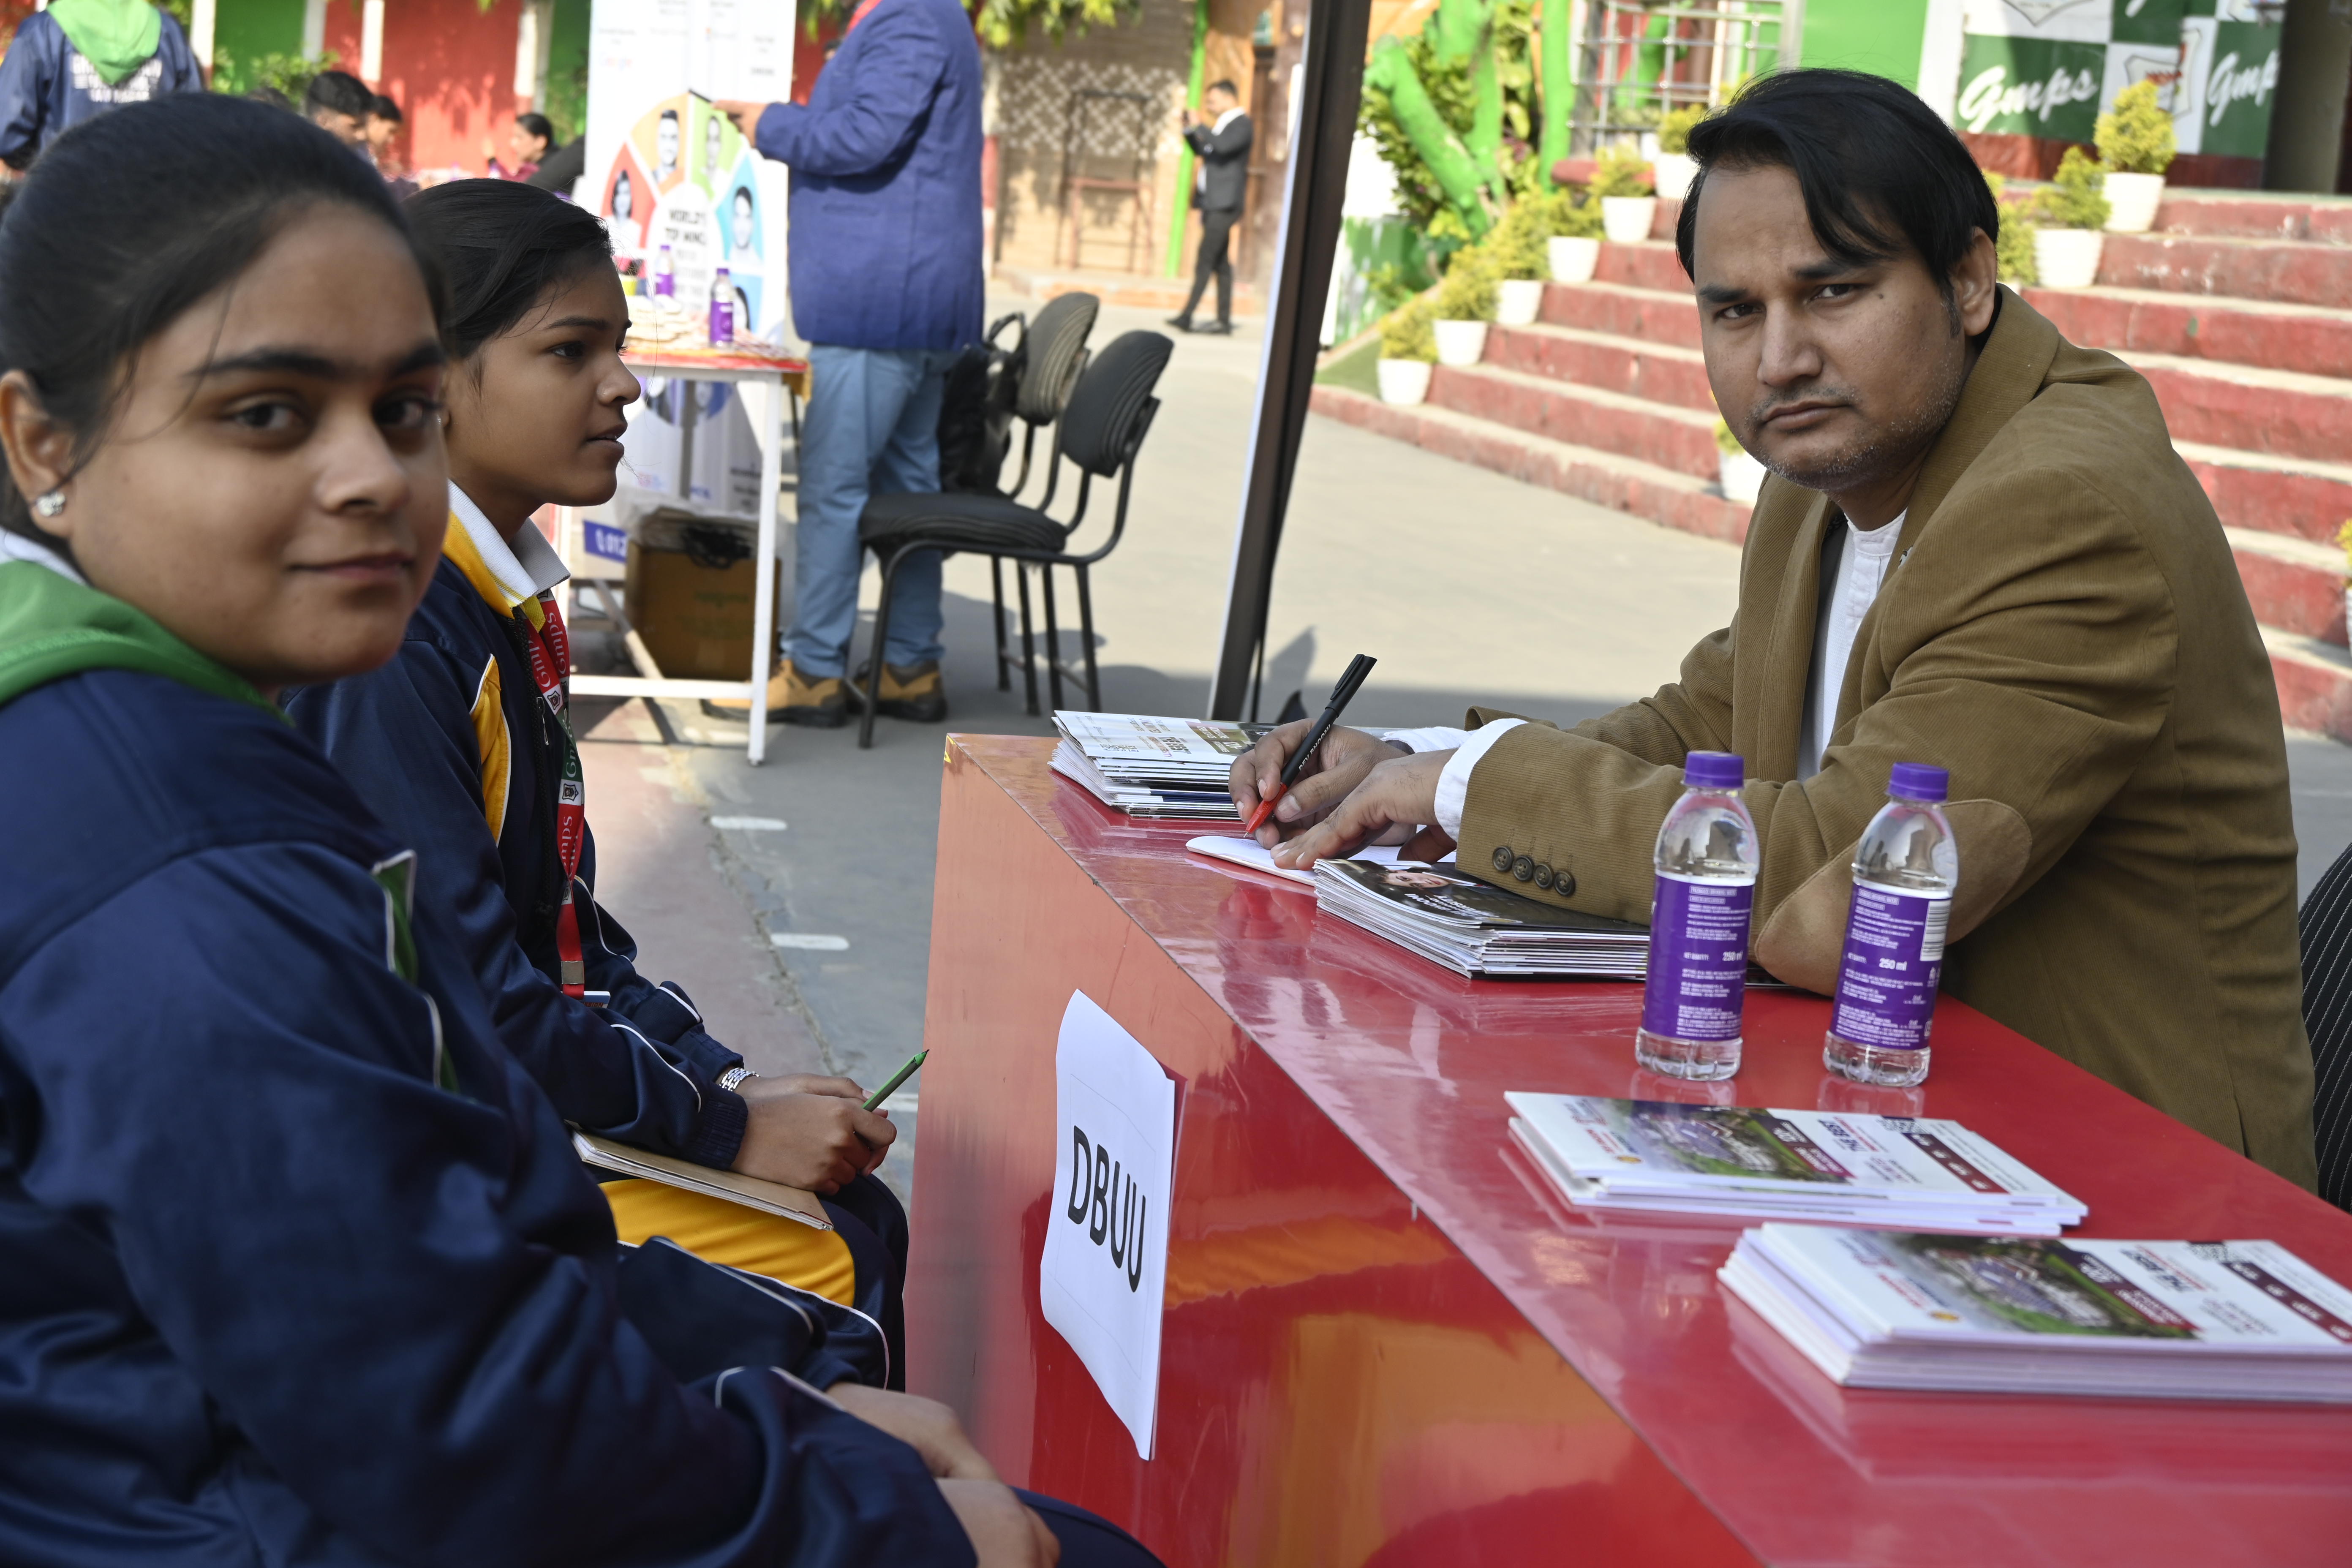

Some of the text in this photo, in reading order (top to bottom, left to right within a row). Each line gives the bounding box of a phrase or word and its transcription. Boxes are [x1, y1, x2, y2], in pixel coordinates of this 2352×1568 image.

[1958, 65, 2099, 134] Gmps
[2206, 49, 2280, 127] Gmp
[528, 639, 551, 688] Gmp
[546, 612, 566, 674] Gmps
[1139, 719, 1162, 733] UNLIMITED
[1165, 743, 1192, 754] BEST
[561, 816, 572, 866] mps
[1722, 951, 1736, 961] 250
[1879, 958, 1896, 969] 250
[1896, 961, 1907, 971] ml
[1067, 1125, 1146, 1293] DBUU
